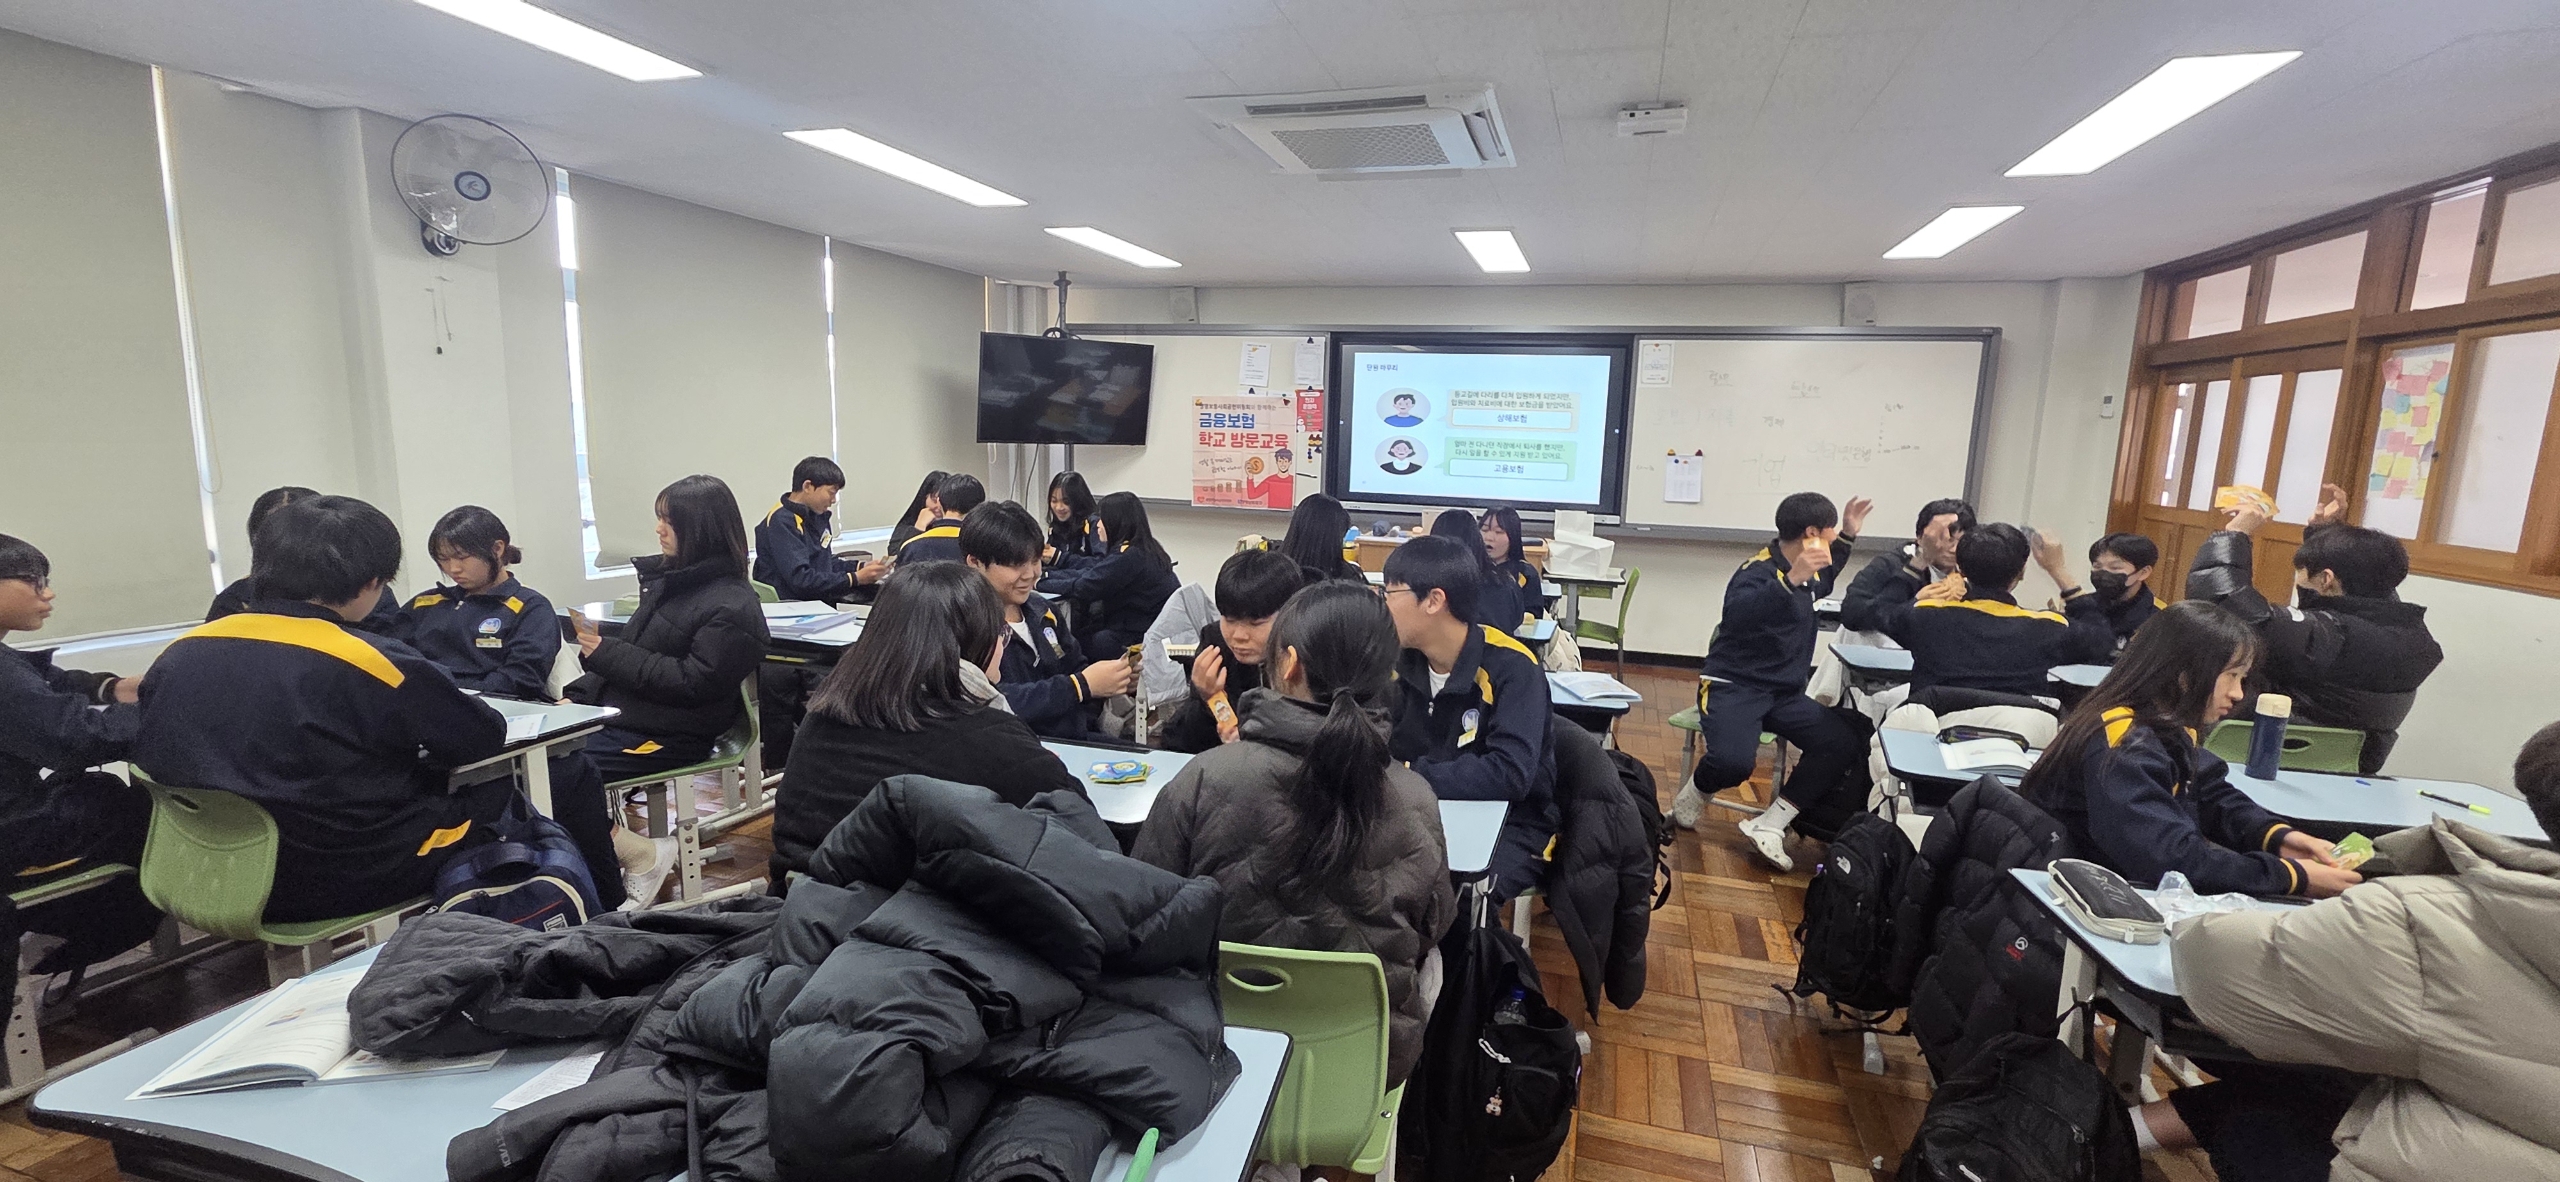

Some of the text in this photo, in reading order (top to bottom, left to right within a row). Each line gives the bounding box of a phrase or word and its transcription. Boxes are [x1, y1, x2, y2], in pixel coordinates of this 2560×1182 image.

[1380, 363, 1398, 372] 마무리
[1480, 390, 1500, 399] 다리를
[1515, 391, 1541, 400] 입원하게
[1451, 399, 1476, 407] 입원비와
[1478, 399, 1503, 408] 치료비에
[1504, 400, 1517, 408] 대한
[1518, 400, 1544, 409] 보험금을
[1199, 412, 1255, 429] 금융보험
[1497, 414, 1528, 424] 상해보험
[1199, 431, 1289, 449] 학교 방문교육
[1493, 463, 1525, 474] 고용보험
